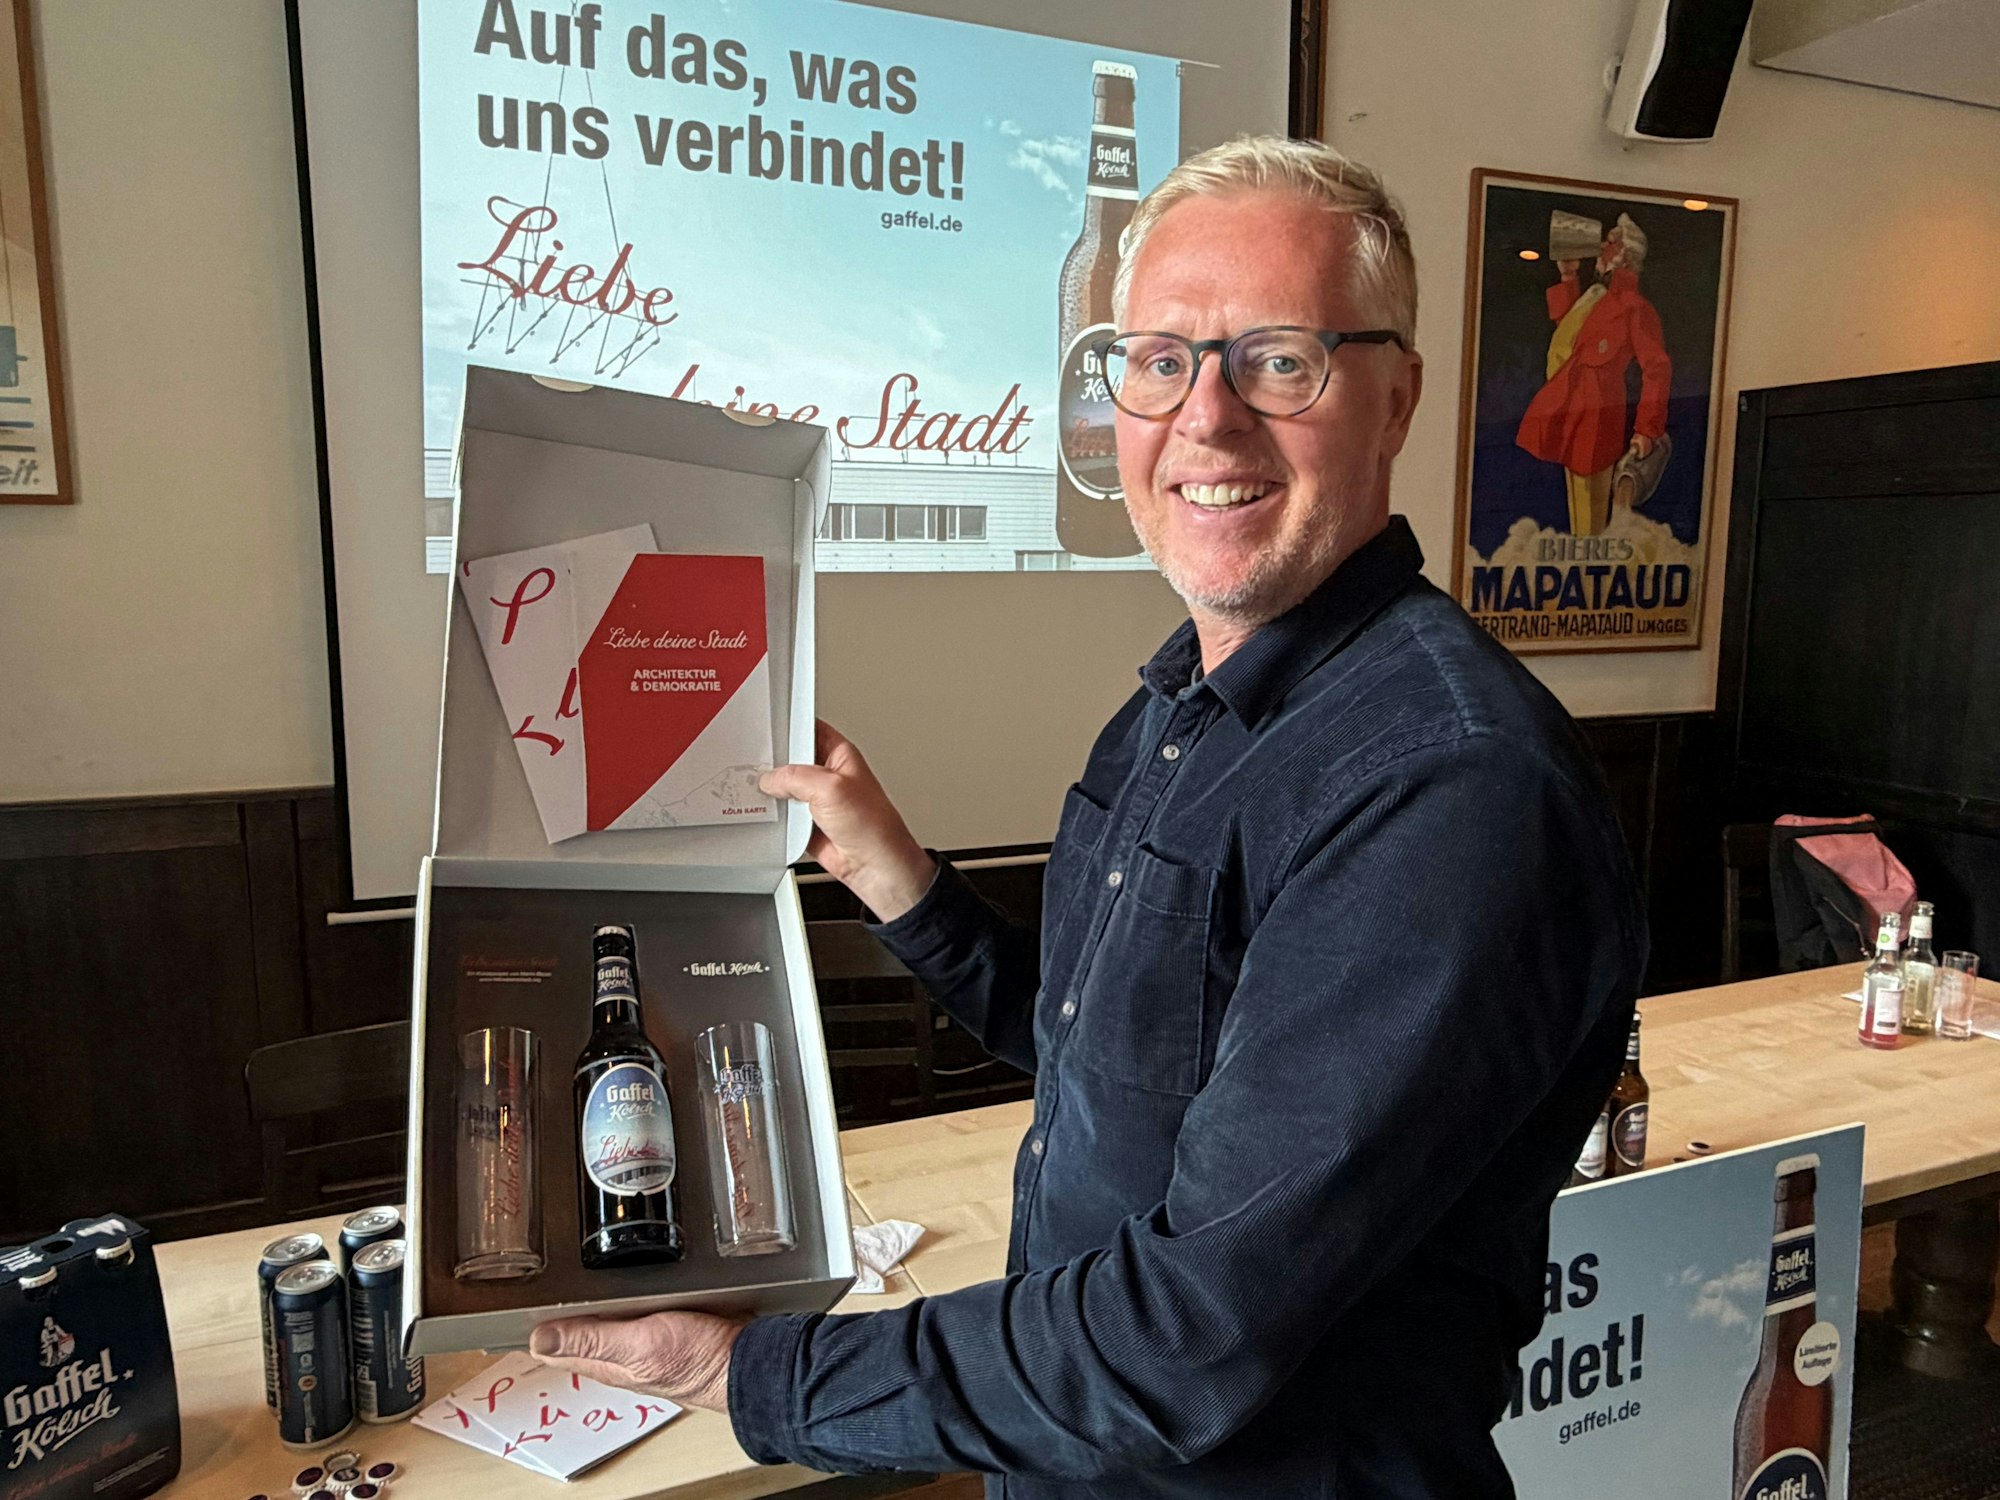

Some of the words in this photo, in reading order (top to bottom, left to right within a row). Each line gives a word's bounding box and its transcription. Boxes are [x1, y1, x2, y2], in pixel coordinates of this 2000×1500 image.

[474, 0, 602, 70] Auf
[626, 13, 768, 107] das,
[789, 50, 918, 115] was
[477, 93, 610, 160] uns
[634, 113, 965, 202] verbindet!
[1096, 144, 1131, 164] Gaffel
[881, 210, 964, 234] gaffel.de
[457, 195, 679, 327] Liebe
[836, 372, 1035, 455] Stadt
[1470, 564, 1691, 612] MAPATAUD
[1473, 612, 1633, 638] ERTRAND-MAPATAUD
[604, 627, 651, 648] Liebe
[653, 630, 697, 649] deine
[699, 629, 748, 649] Stadt
[630, 682, 640, 692] &
[643, 681, 721, 692] DEMOKRATIE
[633, 669, 717, 680] ARCHITEKTUR
[597, 965, 630, 982] Gaffel
[691, 962, 728, 977] Gaffel
[606, 1083, 656, 1103] Gaffel
[607, 1102, 656, 1123] Kölsch
[1775, 1248, 1810, 1273] Gaffel
[1544, 1253, 1599, 1314] as
[4, 1347, 119, 1427] Gaffel
[8, 1386, 121, 1469] Kölsch
[1559, 1400, 1642, 1445] gaffel.de
